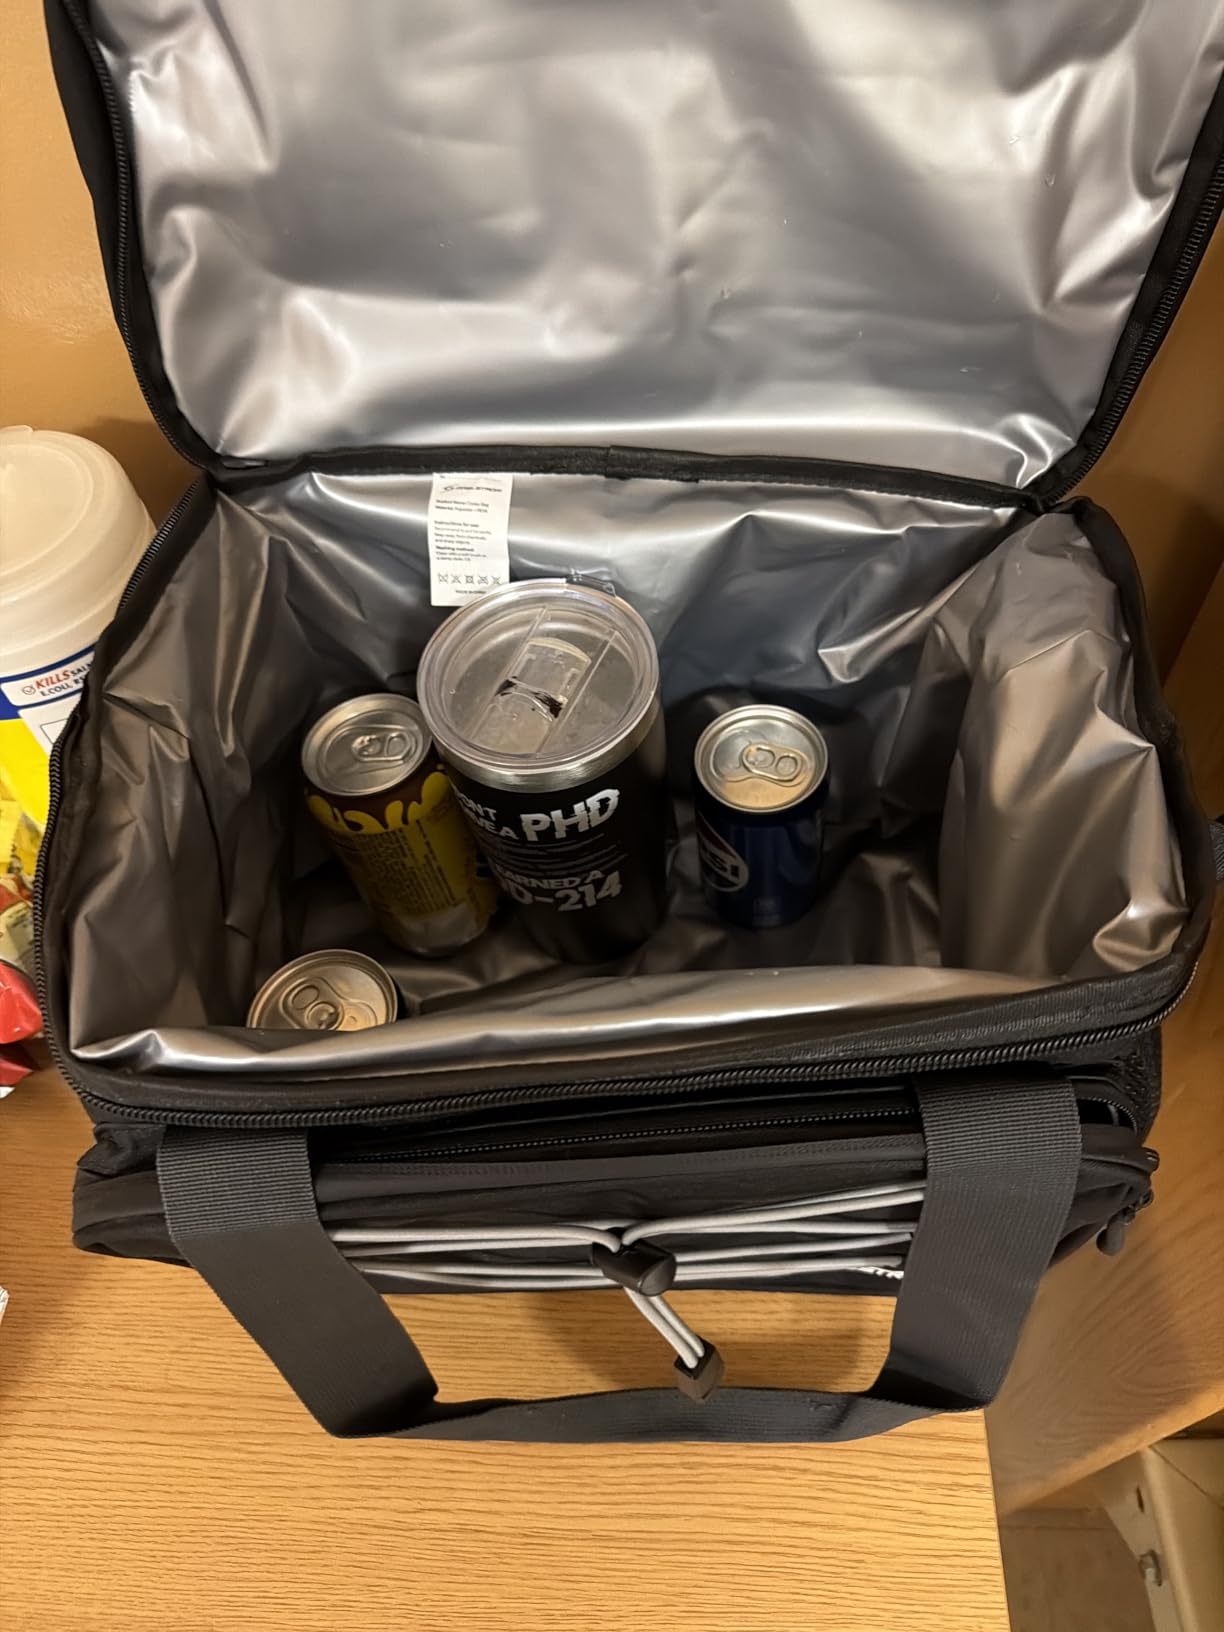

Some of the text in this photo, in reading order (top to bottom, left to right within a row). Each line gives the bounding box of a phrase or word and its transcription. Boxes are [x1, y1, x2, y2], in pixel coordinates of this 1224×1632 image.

[35, 670, 72, 689] KILLS
[498, 824, 520, 840] A
[519, 788, 621, 842] PHD
[584, 870, 606, 884] A
